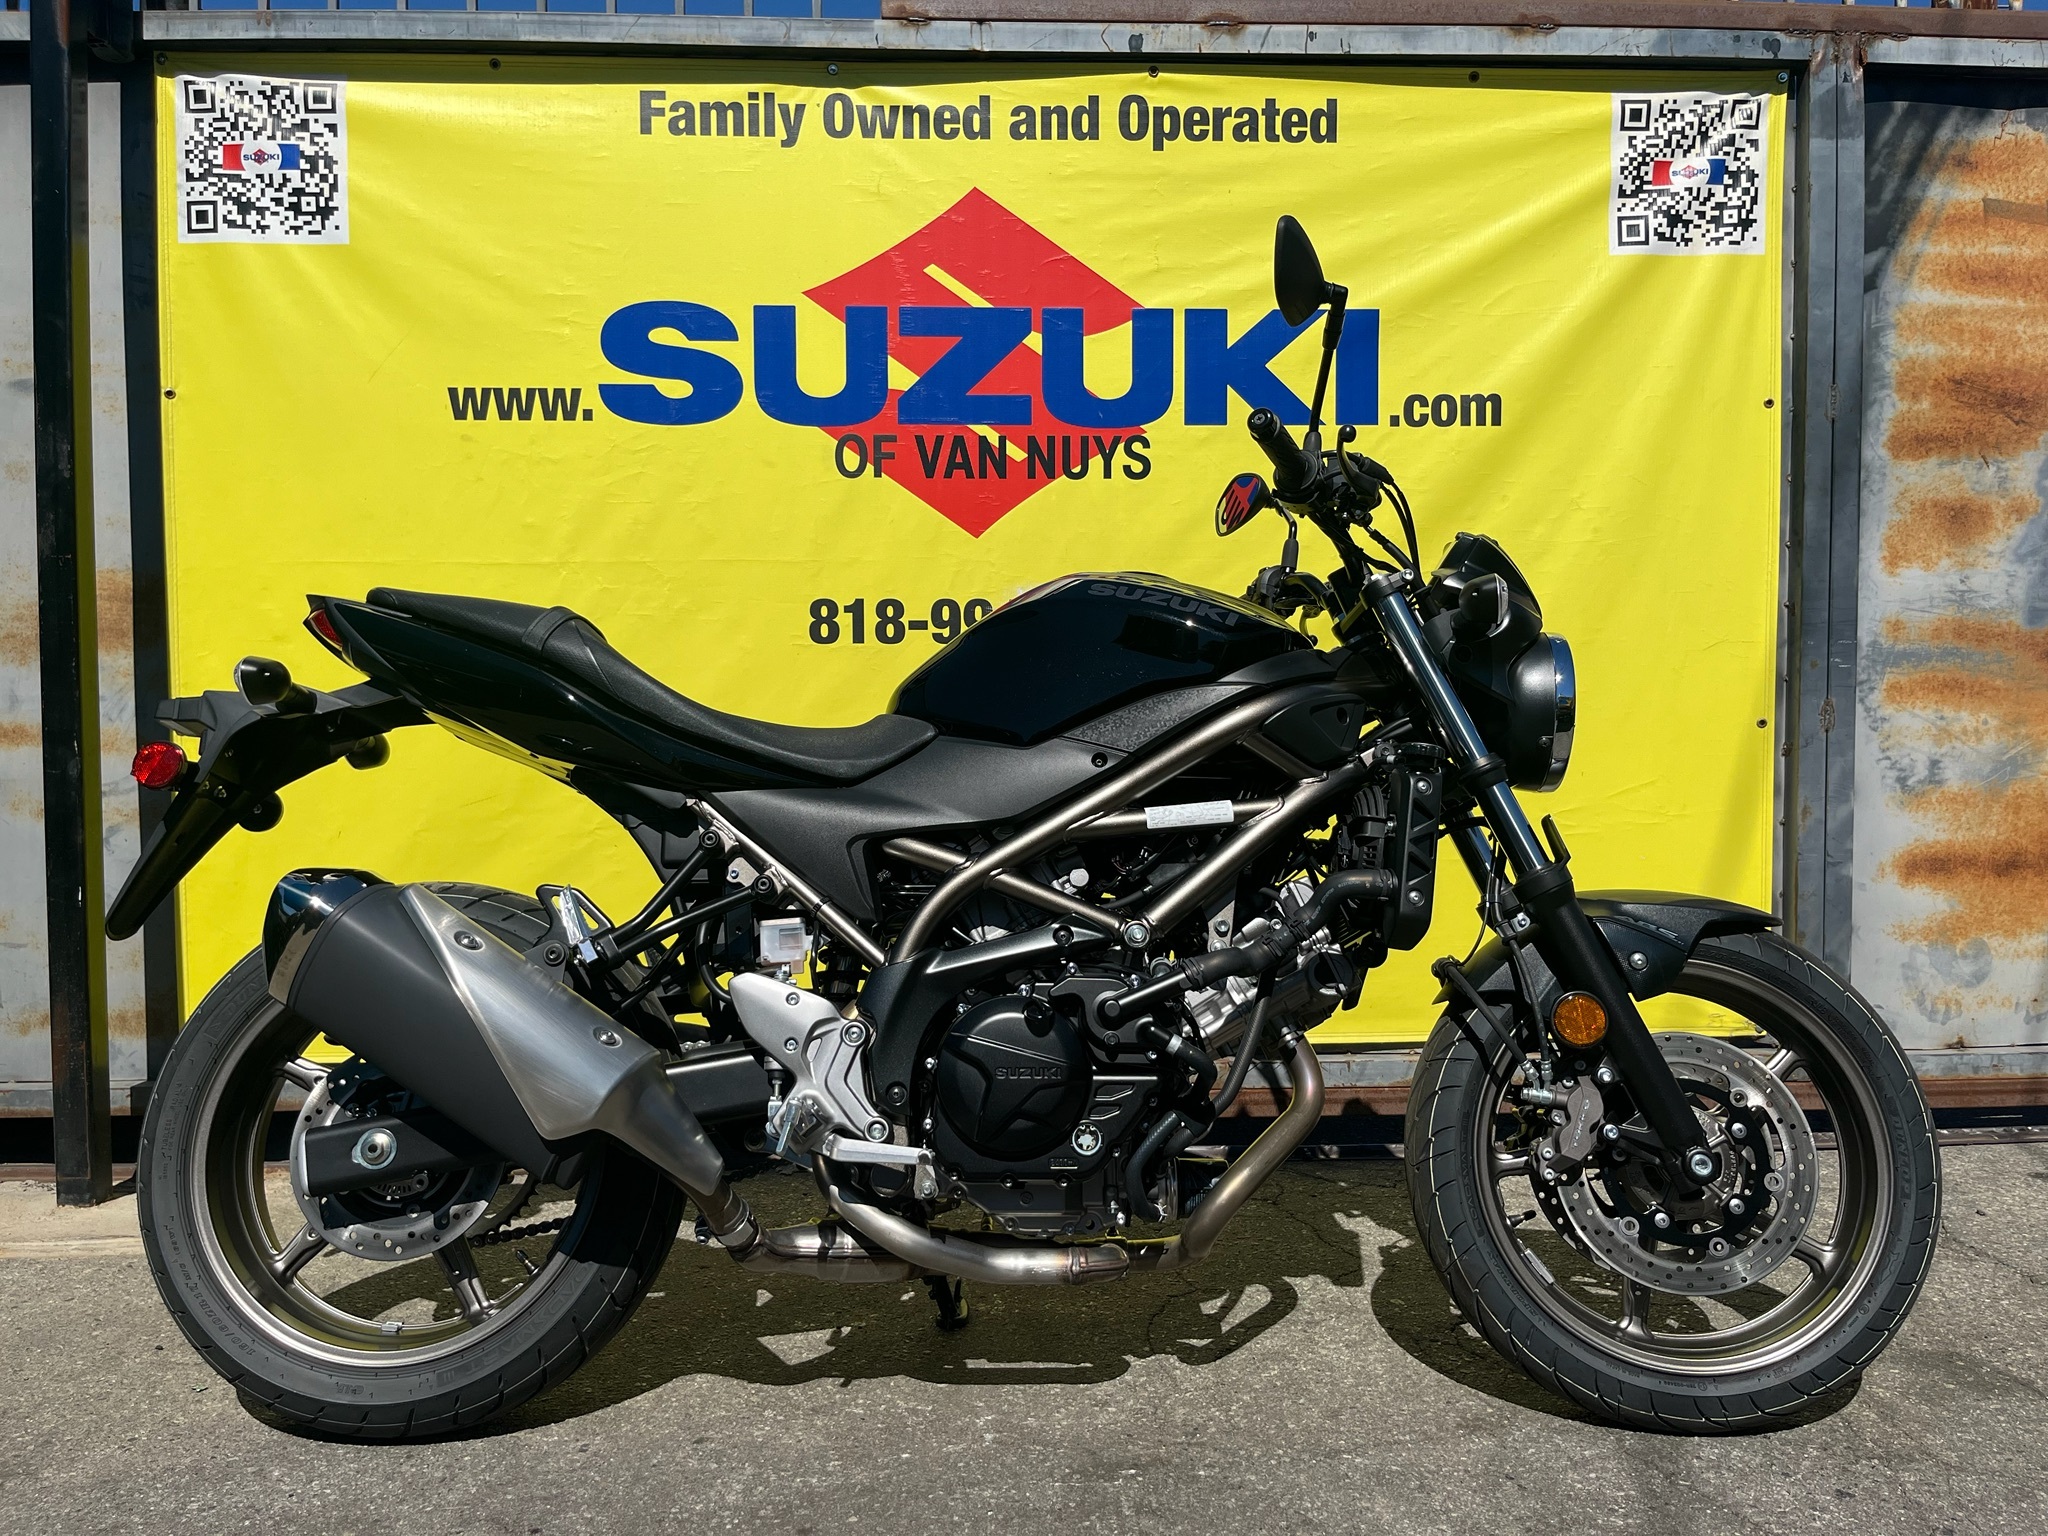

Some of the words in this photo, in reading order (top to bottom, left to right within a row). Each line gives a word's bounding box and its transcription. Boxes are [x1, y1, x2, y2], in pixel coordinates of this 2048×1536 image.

[639, 90, 807, 148] Family
[822, 92, 991, 141] Owned
[1008, 94, 1100, 141] and
[1118, 94, 1338, 152] Operated
[243, 153, 280, 161] SUZUKI
[447, 386, 594, 422] www.
[598, 300, 1380, 428] SUZUKI
[1389, 392, 1503, 428] .com
[834, 433, 898, 479] OF
[914, 434, 1009, 480] VAN
[1026, 434, 1152, 481] NUYS
[1087, 583, 1240, 627] SUZUKI
[995, 1067, 1062, 1080] SUZUKI
